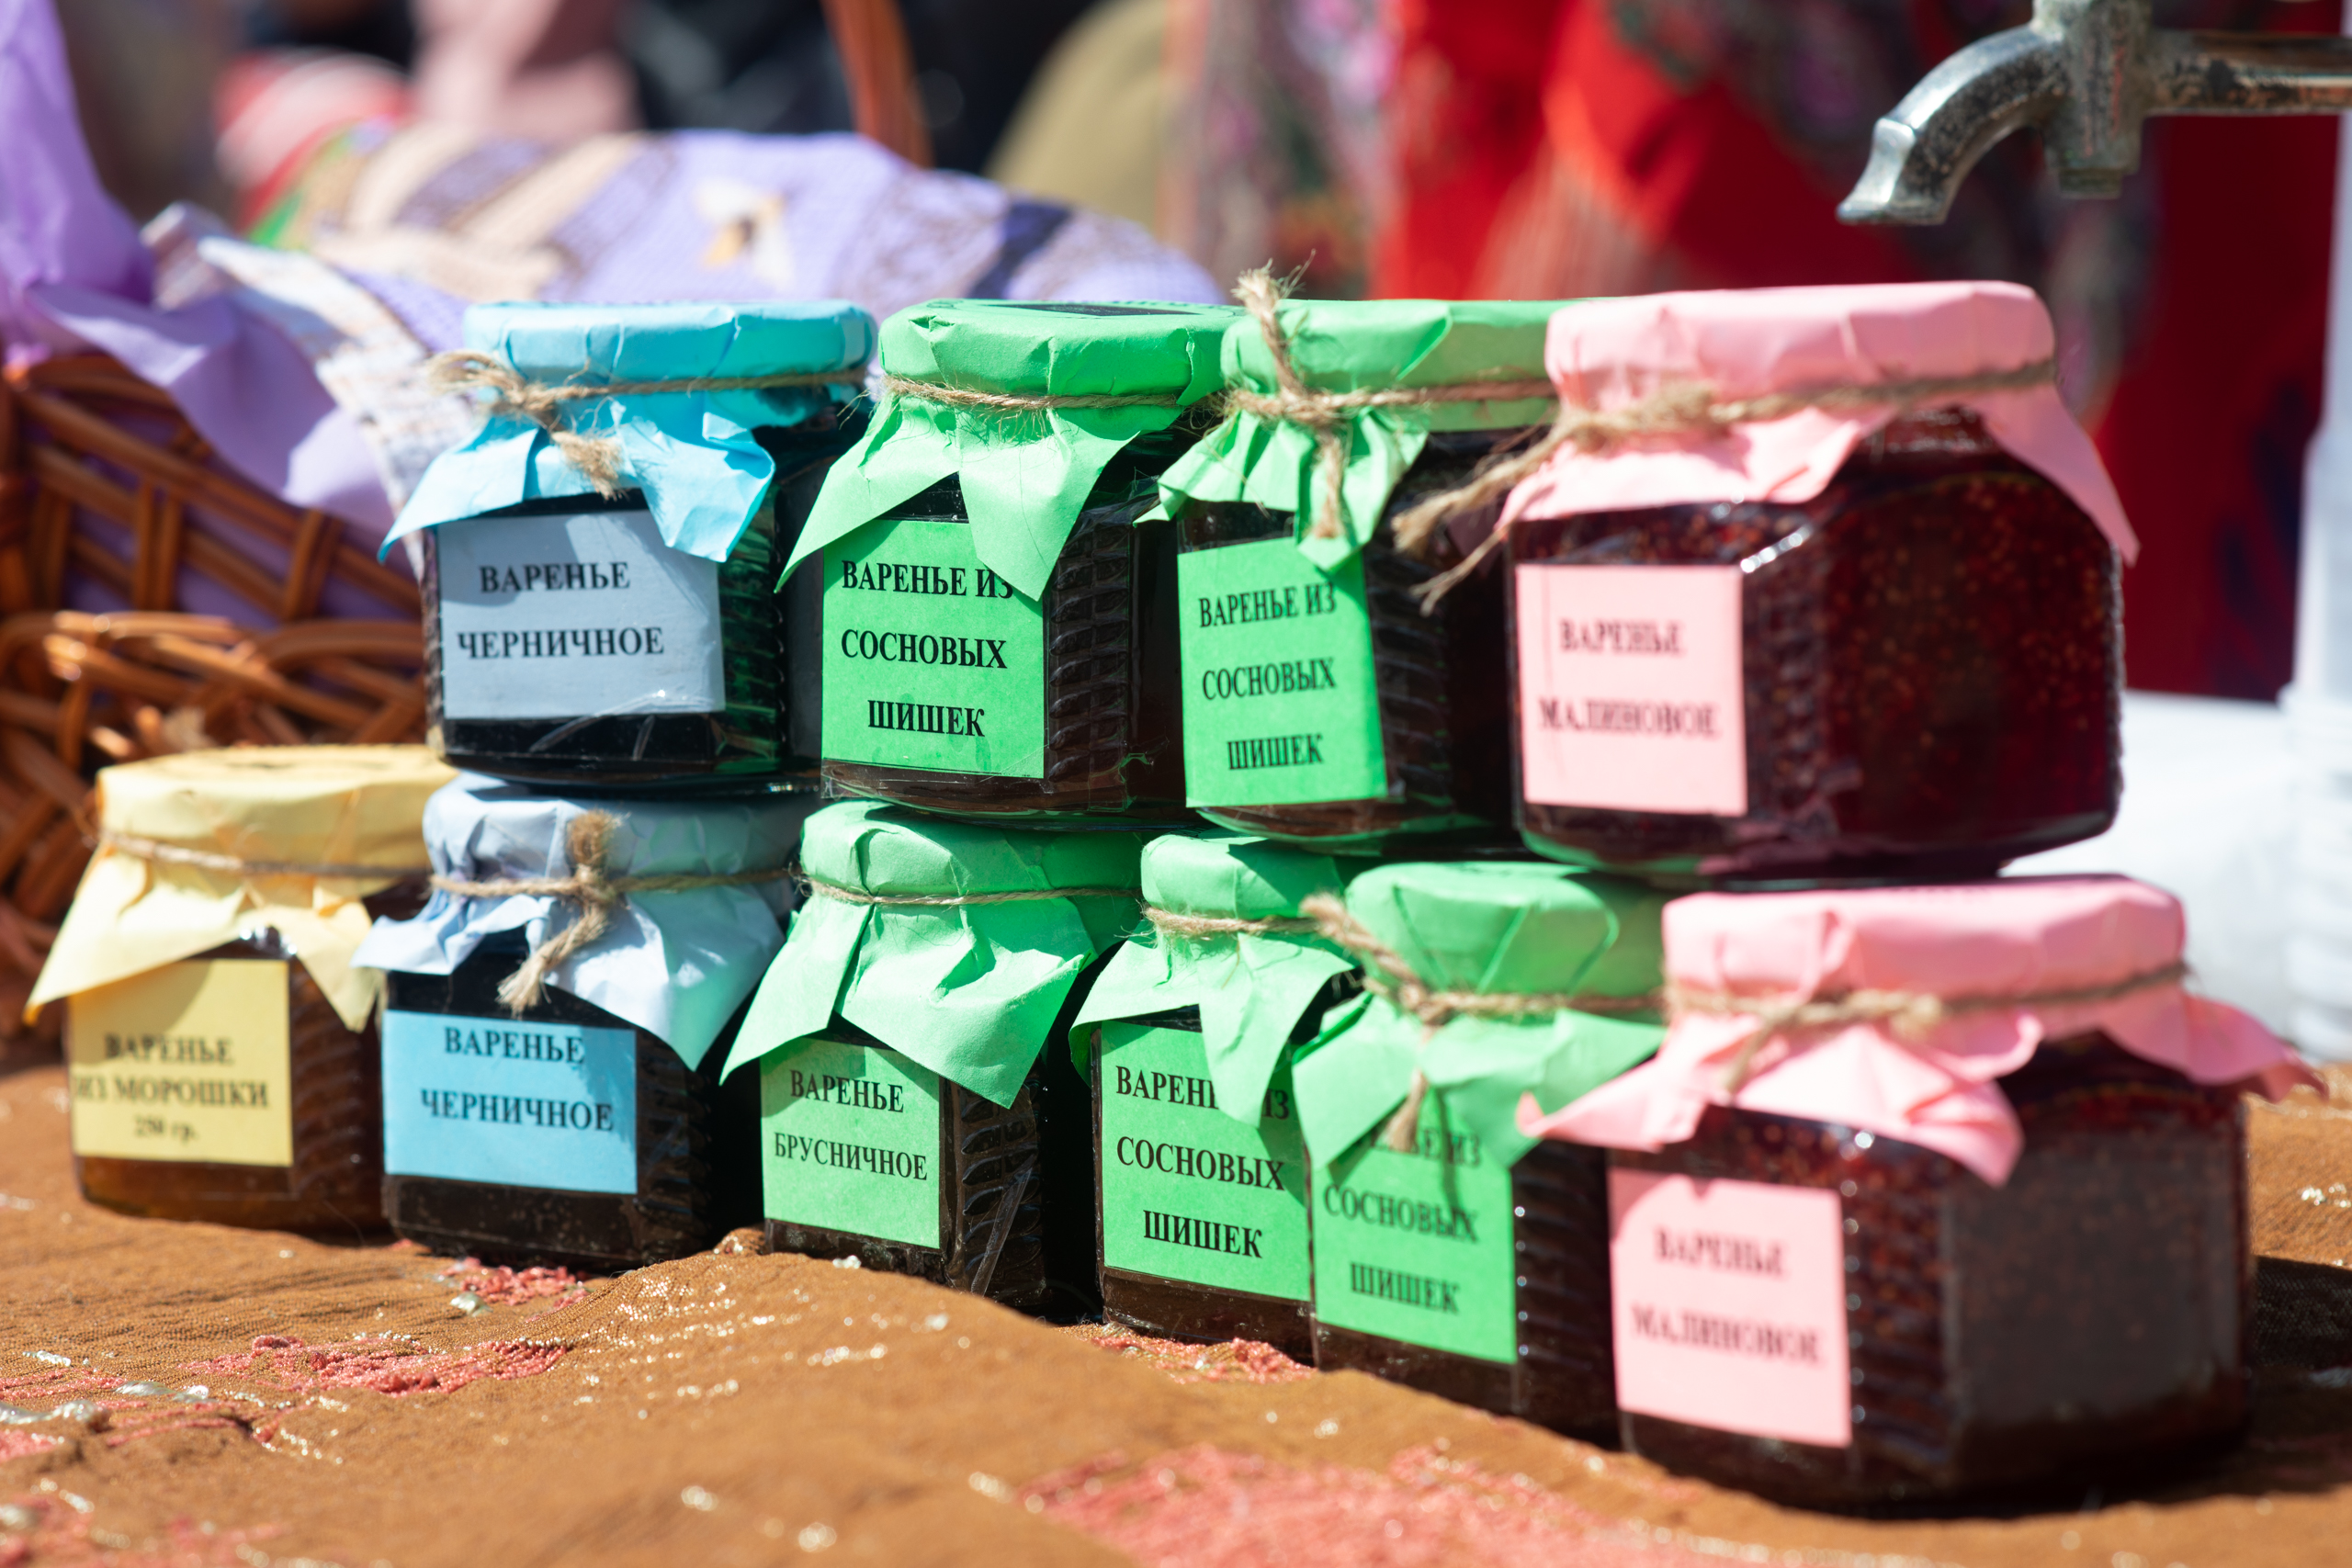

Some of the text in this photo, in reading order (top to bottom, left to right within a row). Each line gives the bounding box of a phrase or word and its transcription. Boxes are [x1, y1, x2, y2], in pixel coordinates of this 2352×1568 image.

[480, 561, 631, 593] ВАРЕНЬЕ
[842, 560, 967, 597] ВАРЕНЬЕ
[1198, 581, 1338, 628] ВАРЕНЬЕ ИЗ
[457, 626, 665, 660] ЧЕРНИЧНОЕ
[841, 628, 1008, 670] СОСНОВЫХ
[1559, 618, 1684, 656] ВАРЕНЬЕ
[1202, 657, 1337, 701] СОСНОВЫХ
[867, 699, 986, 737] ШИШЕК
[1227, 732, 1324, 770] ШИШЕК
[104, 1032, 234, 1066] ВАРЕНЬЕ
[444, 1025, 585, 1065] ВАРЕНЬЕ
[113, 1074, 269, 1108] МОРОШКИ
[789, 1068, 905, 1113] ВАРЕНЬЕ
[1115, 1066, 1219, 1110] ВАРЕН
[420, 1088, 615, 1132] ЧЕРНИЧНОЕ
[774, 1132, 928, 1181] БРУСНИЧНОЕ
[1116, 1135, 1285, 1191] СОСНОВЫХ
[1143, 1209, 1262, 1259] ШИШЕК
[1323, 1183, 1479, 1244] СОСНОВЫХ
[1351, 1261, 1459, 1314] ШИШЕК
